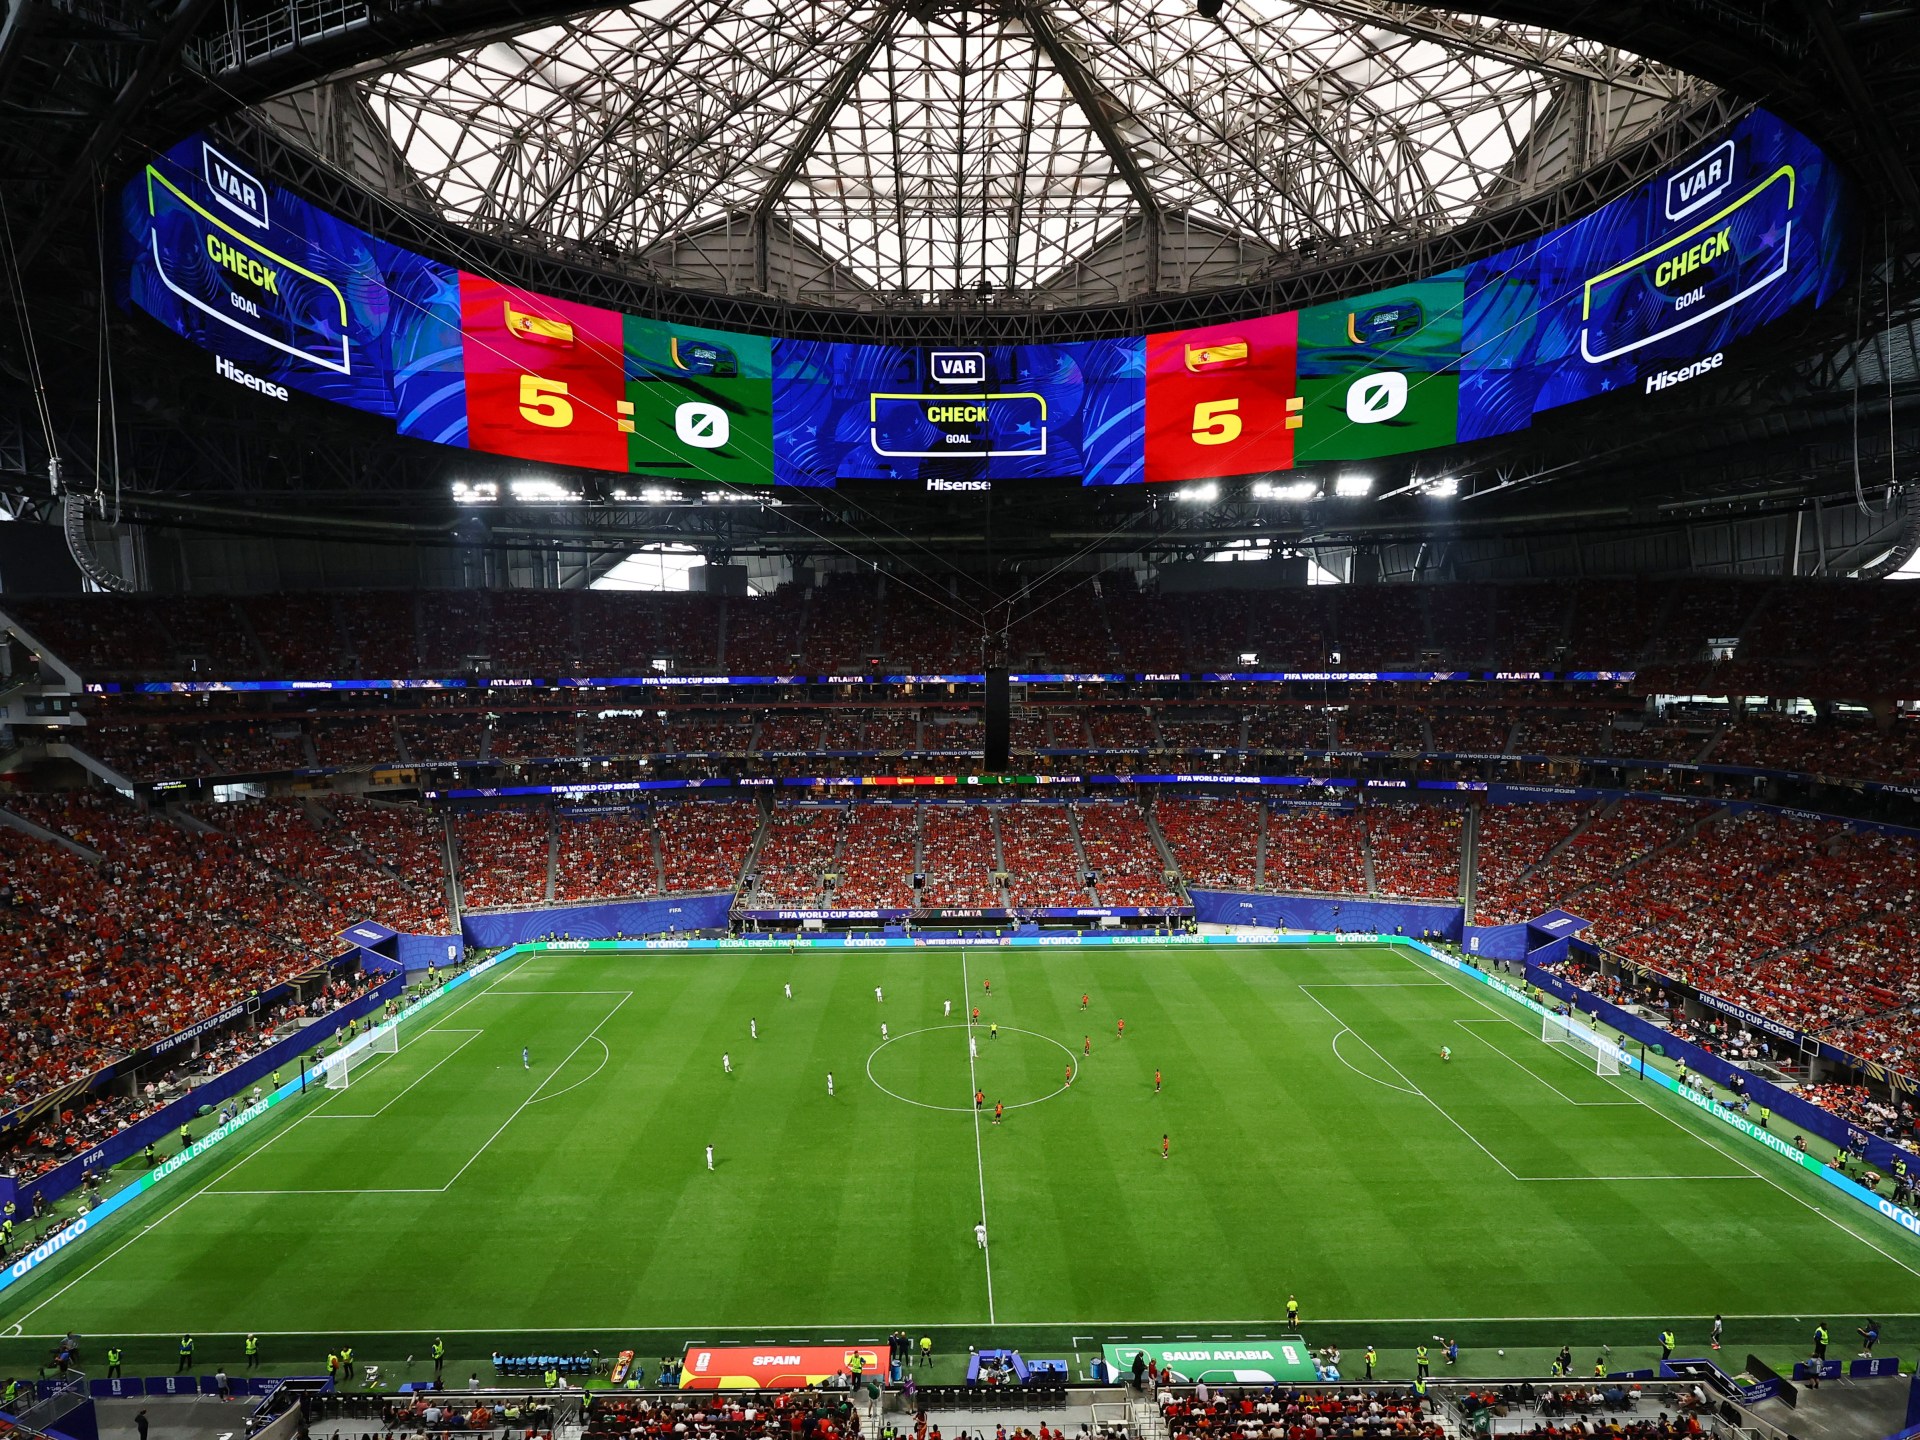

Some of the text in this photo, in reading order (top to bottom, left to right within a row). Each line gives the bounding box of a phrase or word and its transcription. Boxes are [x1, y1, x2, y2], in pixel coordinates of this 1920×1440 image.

[214, 162, 258, 211] VAR
[1678, 158, 1723, 202] VAR
[1654, 225, 1732, 288] CHECK
[206, 233, 279, 296] CHECK
[230, 291, 261, 319] GOAL
[1675, 286, 1706, 312] GOAL
[940, 359, 976, 374] VAR
[1645, 352, 1724, 394] Hisense
[215, 354, 289, 402] Hisense
[518, 374, 574, 428] 5
[927, 406, 989, 423] CHECK
[1191, 398, 1243, 446] 5
[945, 433, 971, 444] GOAL
[926, 478, 991, 491] Hisense
[490, 679, 533, 687] ATLANTA
[642, 678, 659, 686] FIFA
[660, 677, 687, 685] WORLD
[688, 677, 703, 685] CUP
[1496, 672, 1541, 680] ATLANTA
[1367, 780, 1407, 788] ATLANTA
[1881, 784, 1920, 795] ATLAN
[1781, 808, 1822, 820] ATLANTA
[779, 911, 798, 919] FIFA
[798, 911, 830, 919] WORLD
[646, 940, 689, 948] aramco
[719, 940, 748, 948] GLOBAL
[844, 938, 887, 946] aramco
[1039, 937, 1081, 945] aramco
[1112, 936, 1204, 944] GLOBAL ENERGY PARTNER
[1236, 935, 1279, 943] aramco
[1335, 934, 1379, 942] aramco
[546, 941, 590, 950] aramco
[1430, 949, 1460, 969] aramco
[469, 957, 497, 977] aramco
[1487, 978, 1507, 993] GLOBAL
[1551, 979, 1563, 989] FIFA
[368, 991, 379, 1002] FIFA
[1699, 993, 1796, 1040] FIFA WORLD CUP 2026
[155, 1006, 244, 1054] FIFA WORLD CUP 2026
[1677, 1084, 1805, 1166] GLOBAL ENERGY PARTNER
[152, 1099, 270, 1182] GLOBAL ENERGY PARTNER
[83, 1149, 105, 1167] FIFA
[12, 1218, 87, 1278] aramco
[752, 1355, 801, 1366] SPAIN
[1161, 1350, 1275, 1361] SAUDI ARABIA
